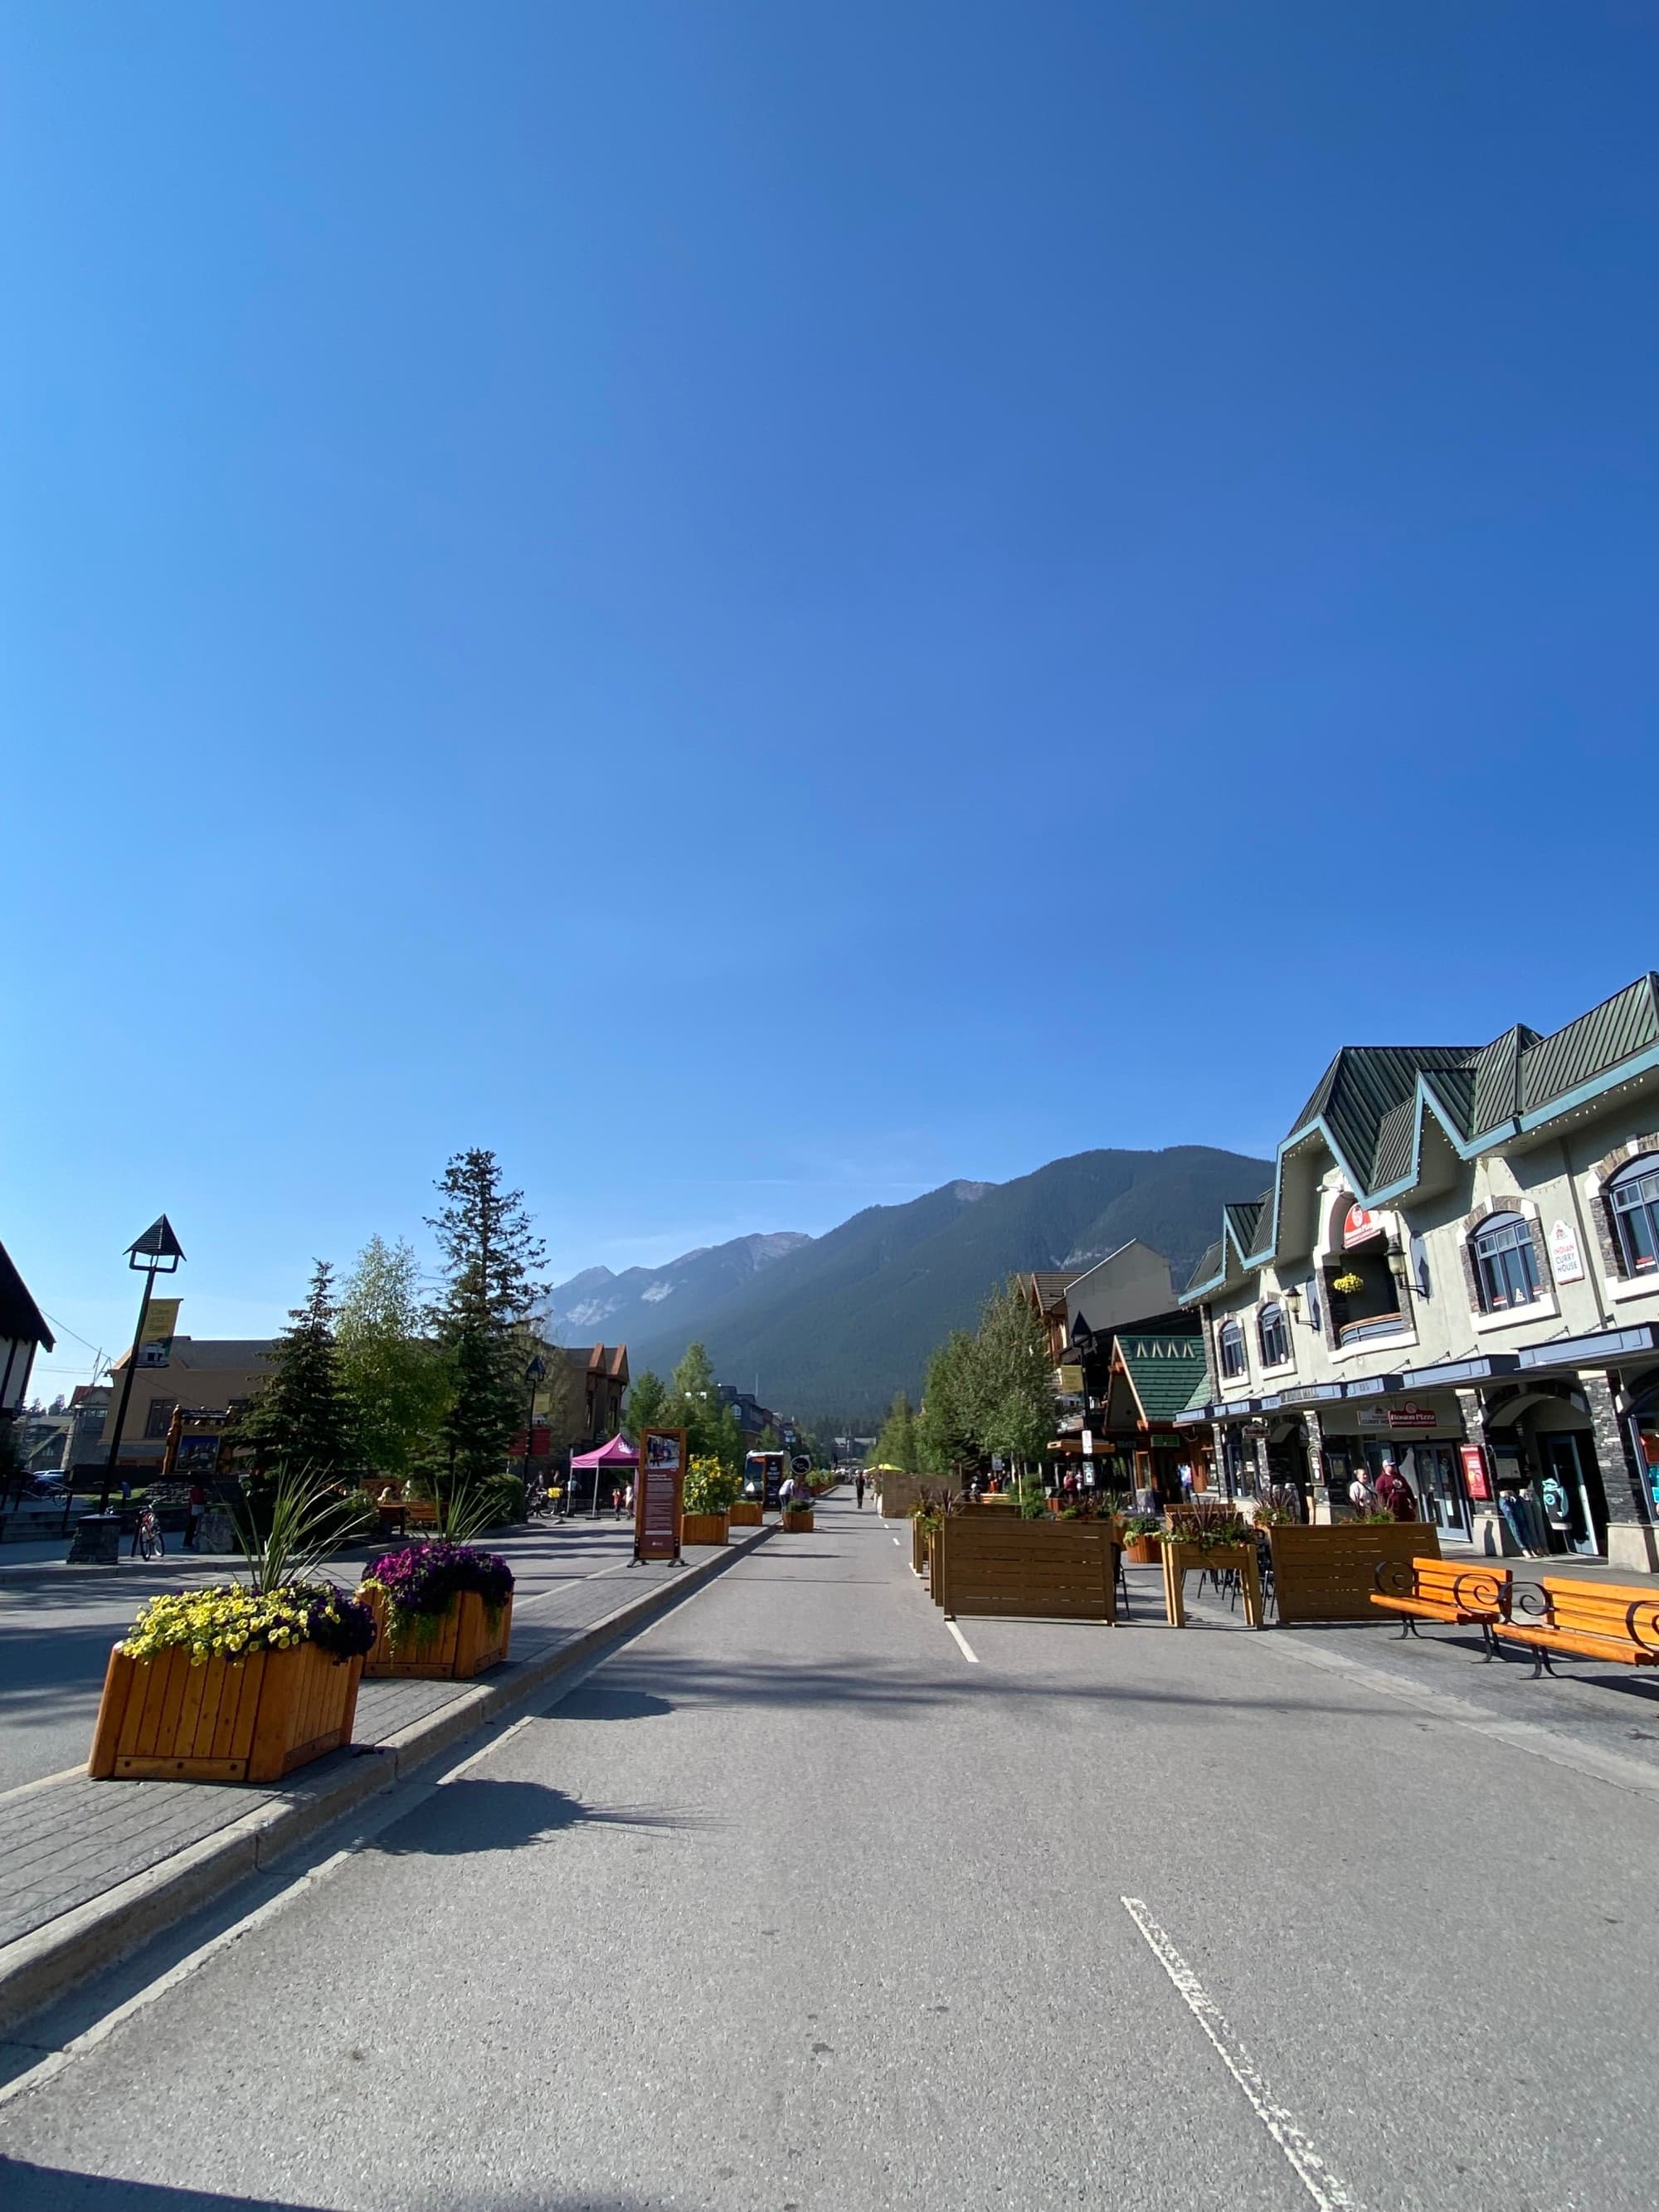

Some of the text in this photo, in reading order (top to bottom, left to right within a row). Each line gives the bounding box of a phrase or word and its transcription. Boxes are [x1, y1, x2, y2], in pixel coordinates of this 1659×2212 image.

[1554, 1244, 1574, 1255] INDIAN
[1556, 1253, 1575, 1264] CURRY
[1558, 1262, 1578, 1272] HOUSE
